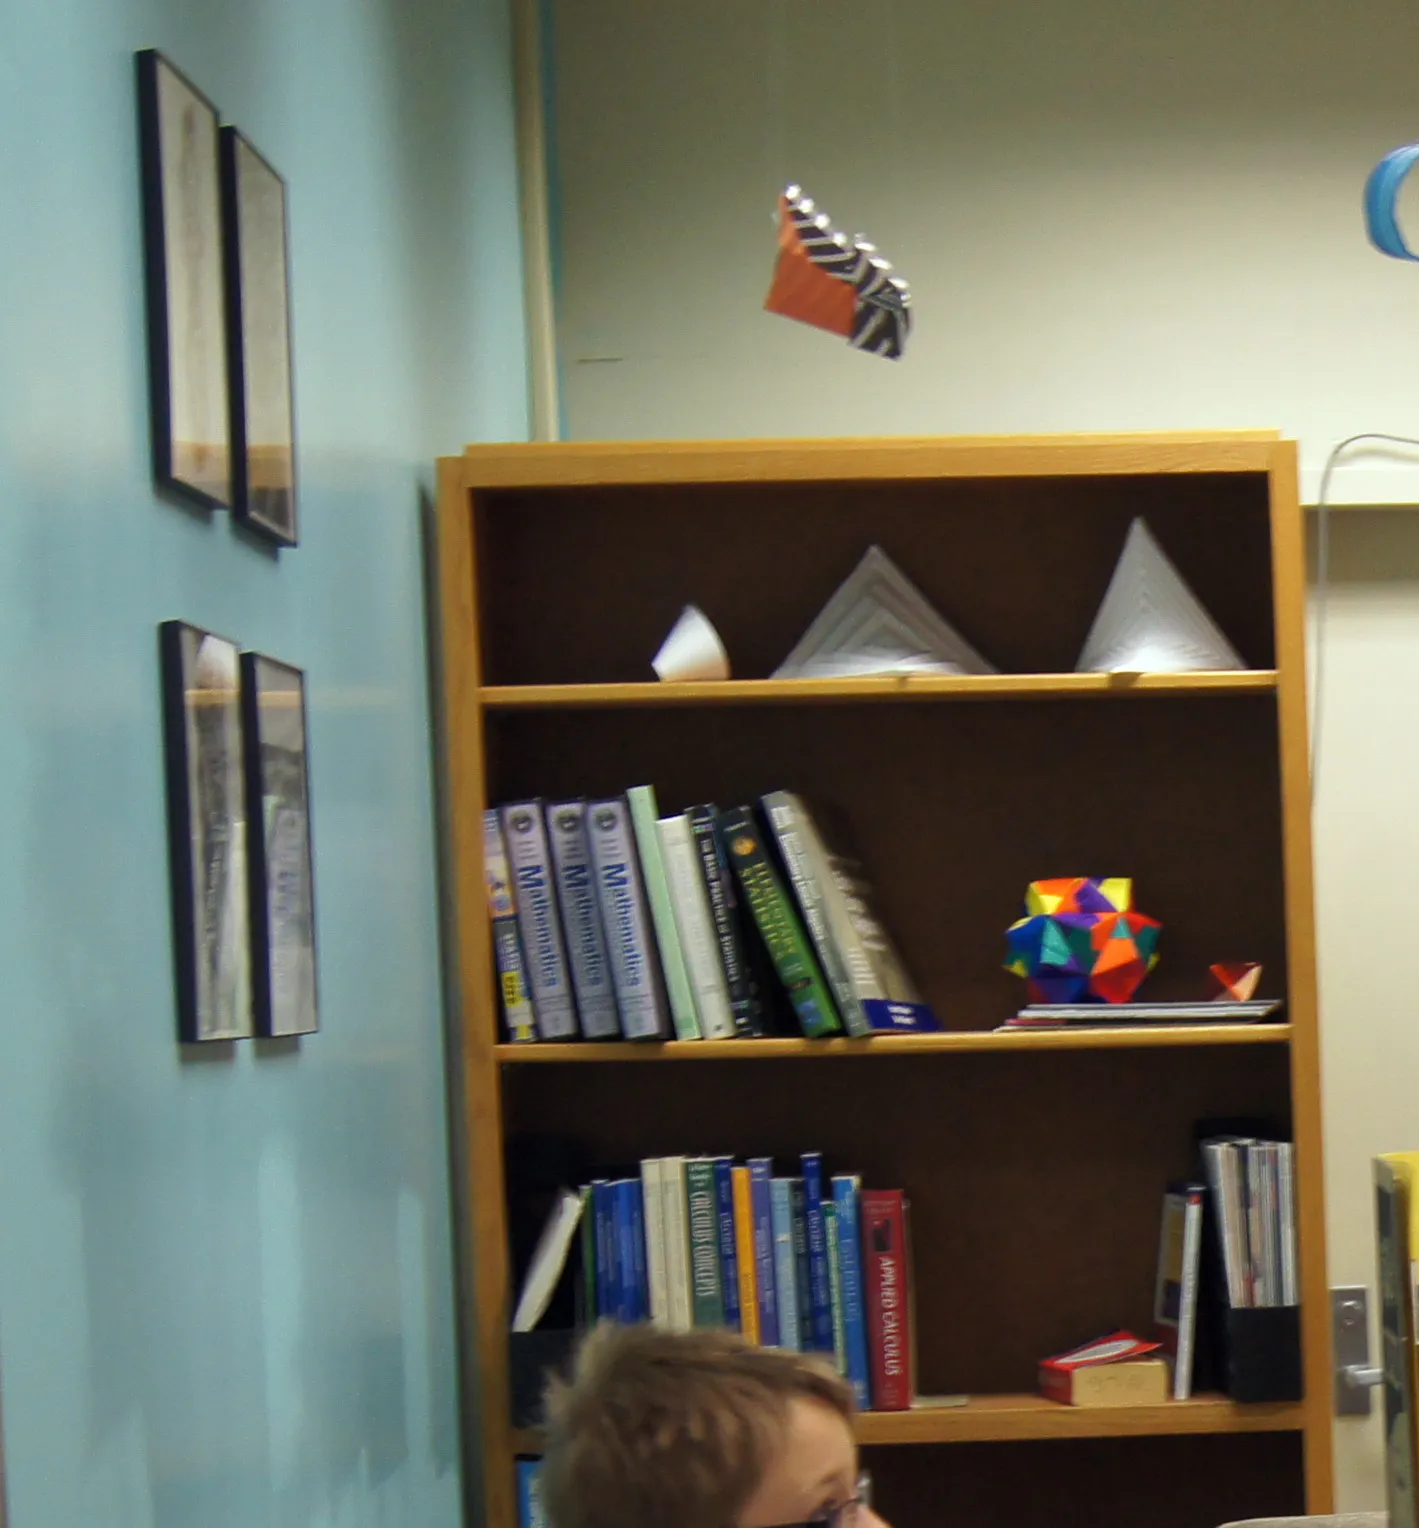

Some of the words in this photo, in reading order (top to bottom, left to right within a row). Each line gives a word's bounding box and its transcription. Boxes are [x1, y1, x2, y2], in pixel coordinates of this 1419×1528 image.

[517, 863, 561, 988] Mathematics
[561, 864, 604, 988] Mathematics
[601, 862, 644, 988] Mathematics
[738, 868, 785, 961] STATISTICS
[752, 862, 797, 953] ELEMENTARY
[689, 1190, 714, 1242] CALCULUS
[693, 1245, 717, 1296] CONCEPTS
[879, 1256, 899, 1308] APPLIED
[882, 1310, 904, 1376] CALCULUS
